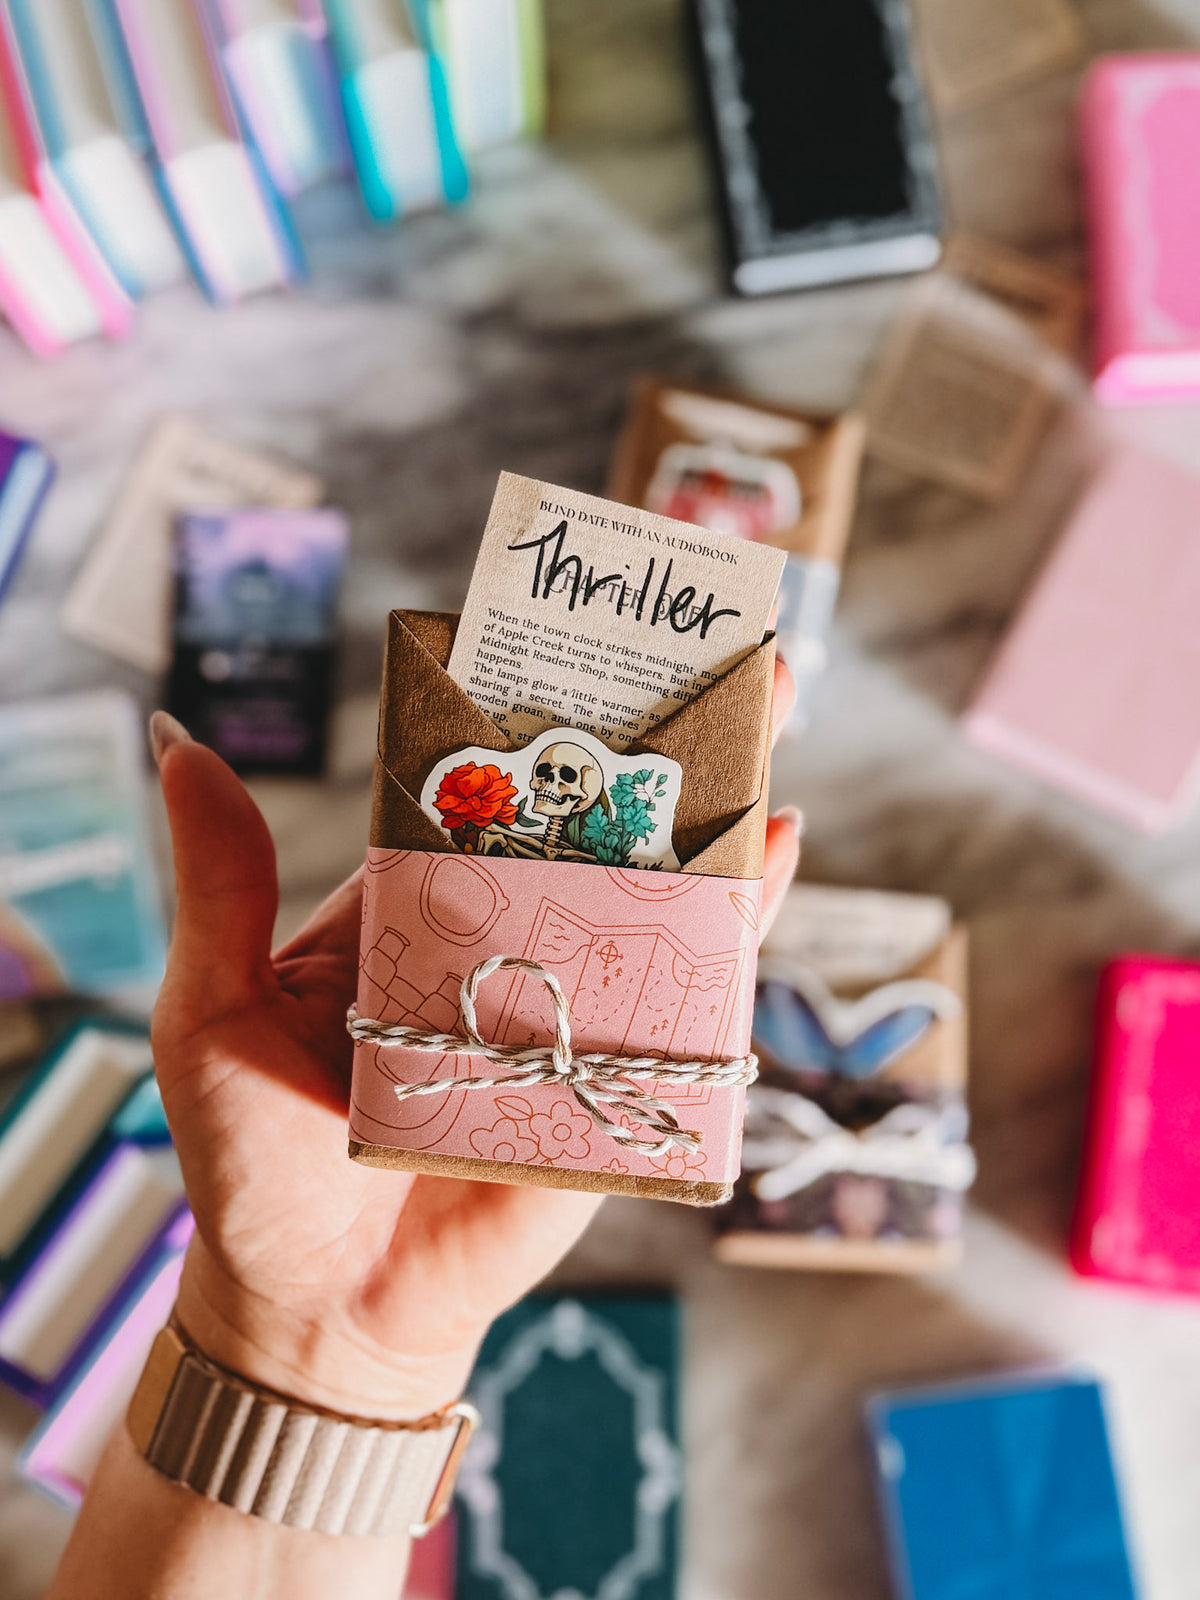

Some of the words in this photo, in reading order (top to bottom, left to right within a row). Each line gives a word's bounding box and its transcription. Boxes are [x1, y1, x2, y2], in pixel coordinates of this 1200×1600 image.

[540, 501, 576, 518] BLIND
[578, 511, 608, 528] DATE
[612, 520, 642, 538] WITH
[644, 530, 662, 544] AN
[662, 536, 740, 565] AUDIOBOOK
[508, 520, 741, 640] Thriller
[476, 648, 524, 670] happens.
[480, 635, 530, 656] Midnight
[532, 650, 576, 670] Readers
[578, 663, 608, 680] Shop,
[612, 674, 670, 699] something
[672, 690, 694, 703] diff
[484, 622, 497, 632] of
[498, 626, 529, 642] Apple
[532, 636, 564, 652] Creek
[567, 646, 596, 661] turns
[600, 655, 611, 666] to
[615, 660, 665, 681] whispers.
[670, 674, 689, 688] But
[488, 608, 518, 626] When
[522, 619, 540, 630] the
[544, 625, 570, 640] town
[574, 634, 603, 649] clock
[606, 644, 642, 660] strikes
[646, 654, 696, 677] midnight,
[700, 670, 722, 681] mo
[466, 689, 508, 708] wooden
[512, 702, 546, 720] groan,
[551, 714, 572, 726] and
[576, 720, 596, 733] one
[600, 726, 614, 740] by
[468, 676, 511, 697] sharing
[516, 689, 523, 698] a
[528, 693, 565, 710] secret.
[574, 704, 594, 718] The
[600, 712, 640, 731] shelves
[474, 661, 494, 674] The
[496, 667, 529, 686] lamps
[532, 679, 559, 692] glow
[561, 688, 568, 696] a
[571, 688, 598, 704] little
[602, 700, 645, 719] warmer,
[648, 712, 661, 722] as
[517, 732, 536, 743] str
